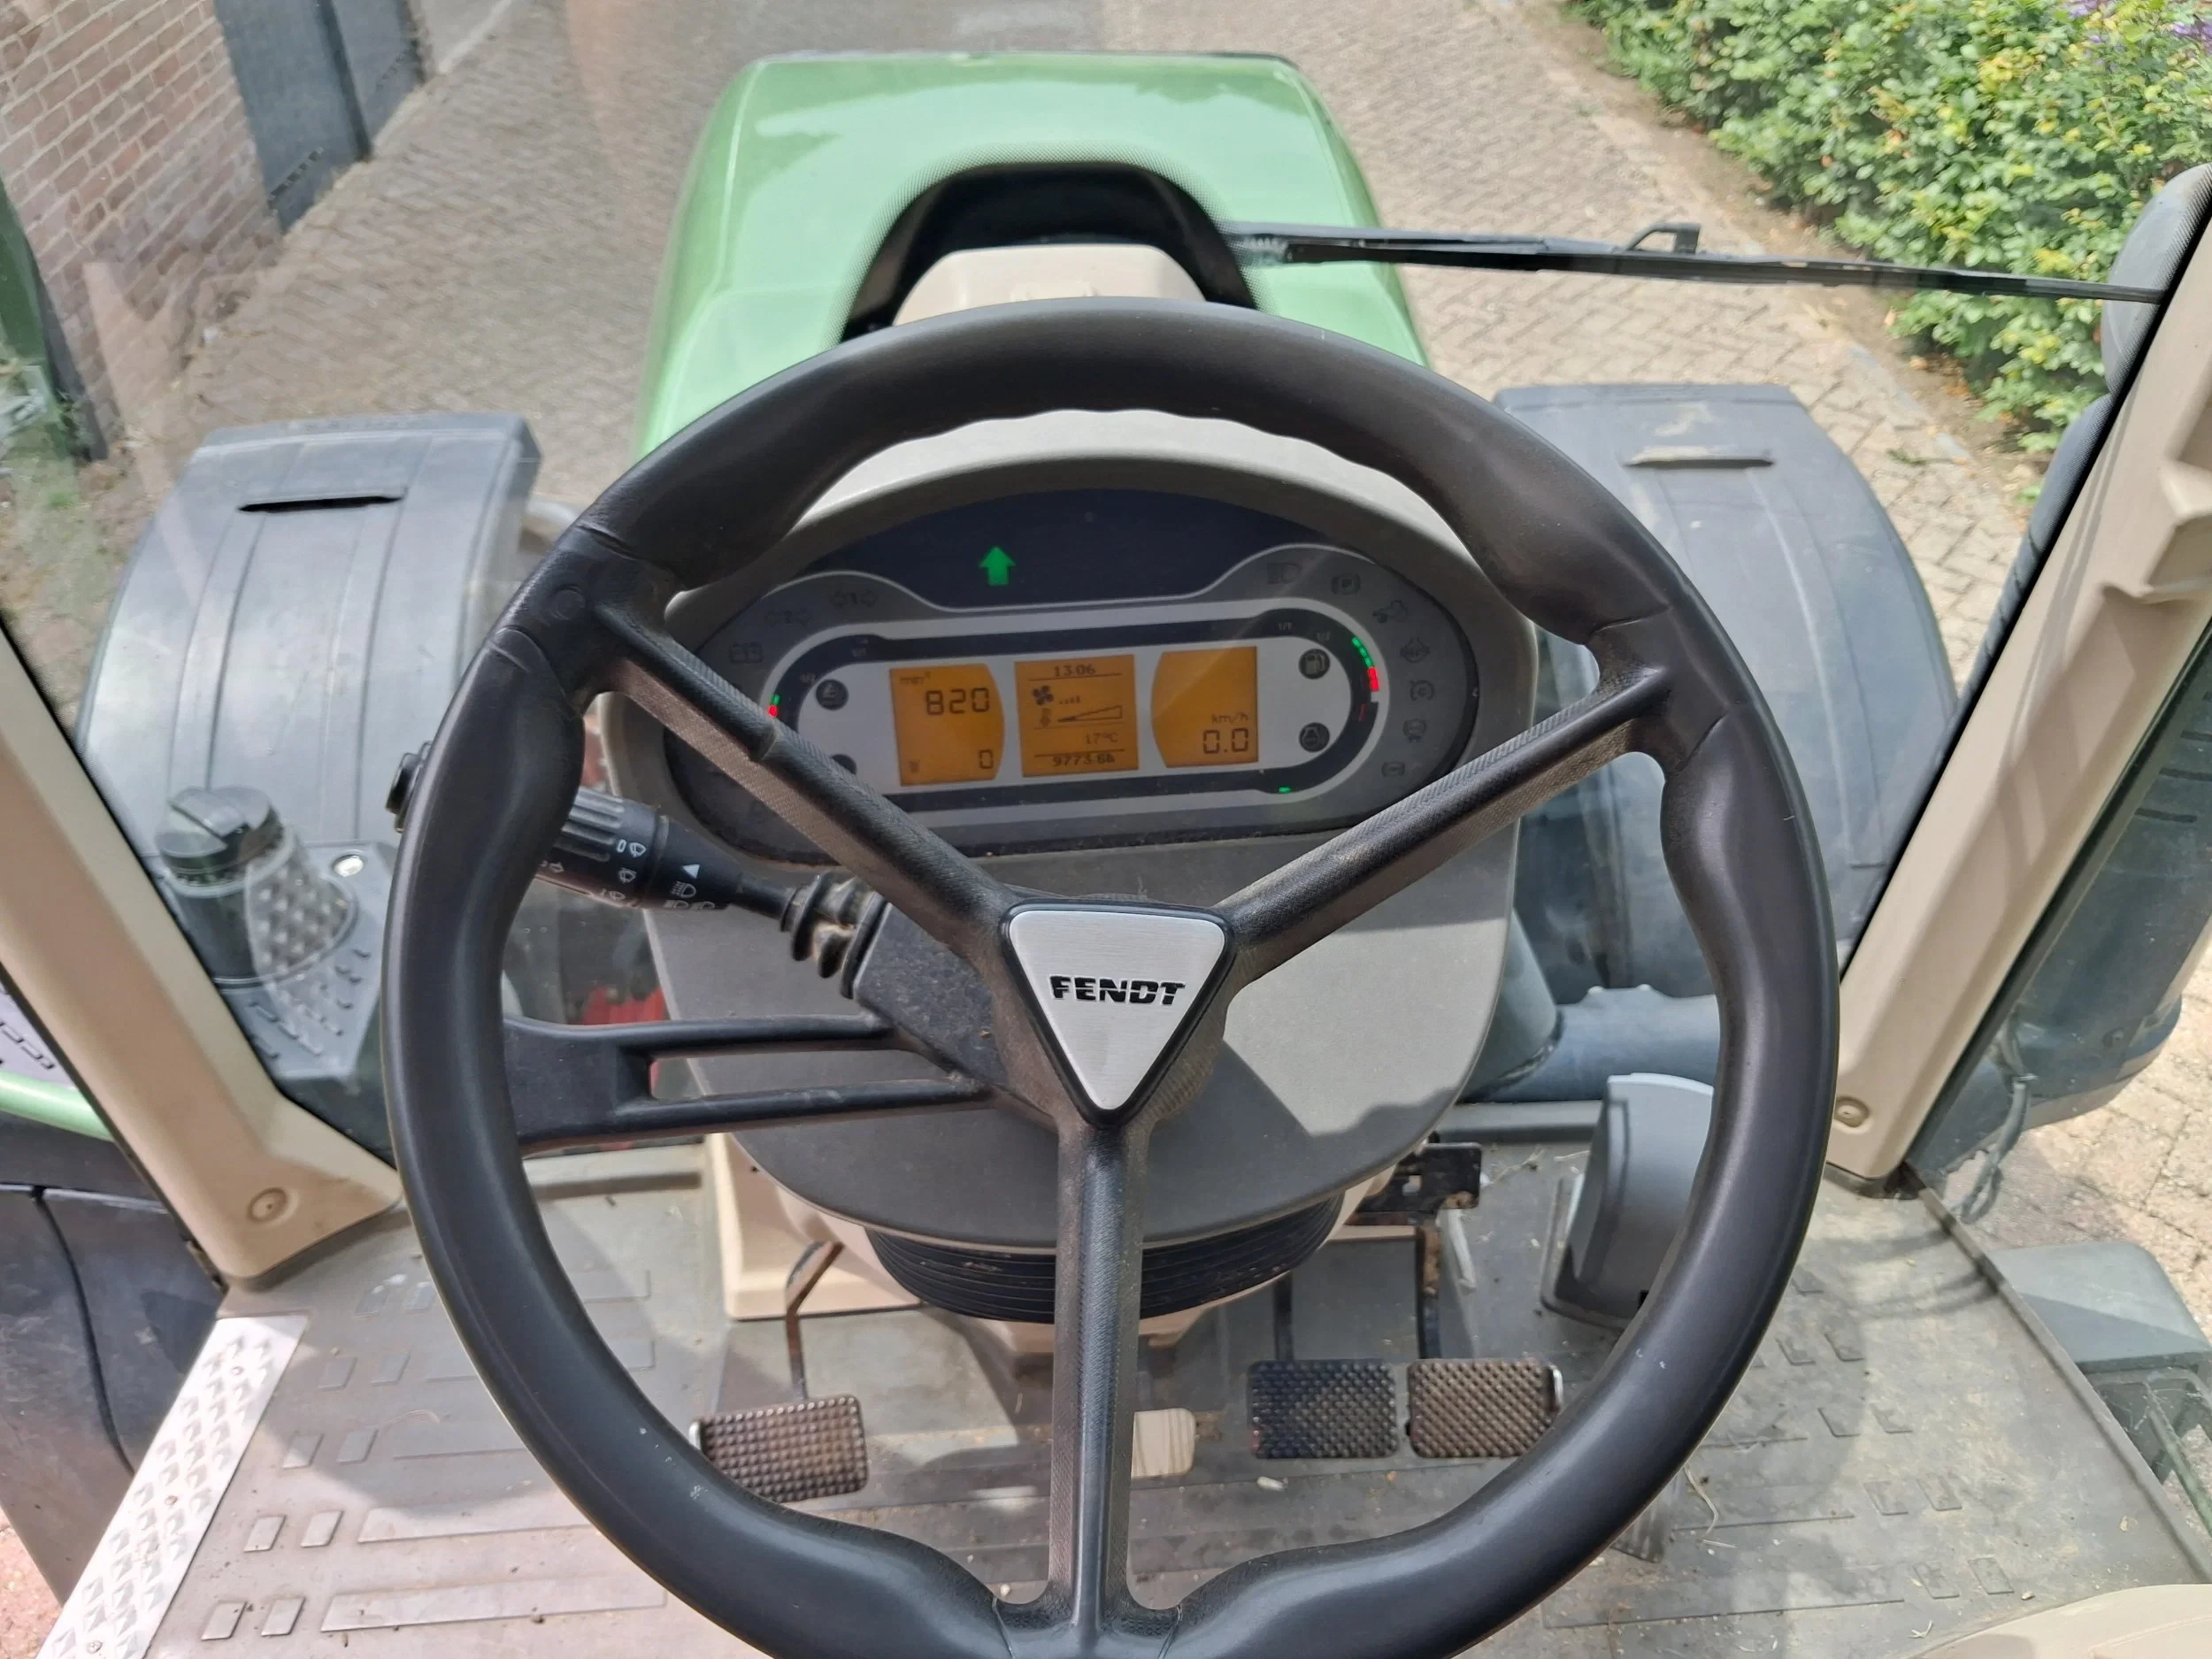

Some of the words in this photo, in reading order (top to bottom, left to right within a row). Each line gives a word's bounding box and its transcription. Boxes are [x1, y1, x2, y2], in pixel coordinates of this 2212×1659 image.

[925, 686, 990, 716] 820
[1210, 711, 1248, 725] km/h
[1202, 727, 1249, 755] 0.0
[977, 748, 995, 770] 0
[1049, 975, 1186, 1005] FENDT
